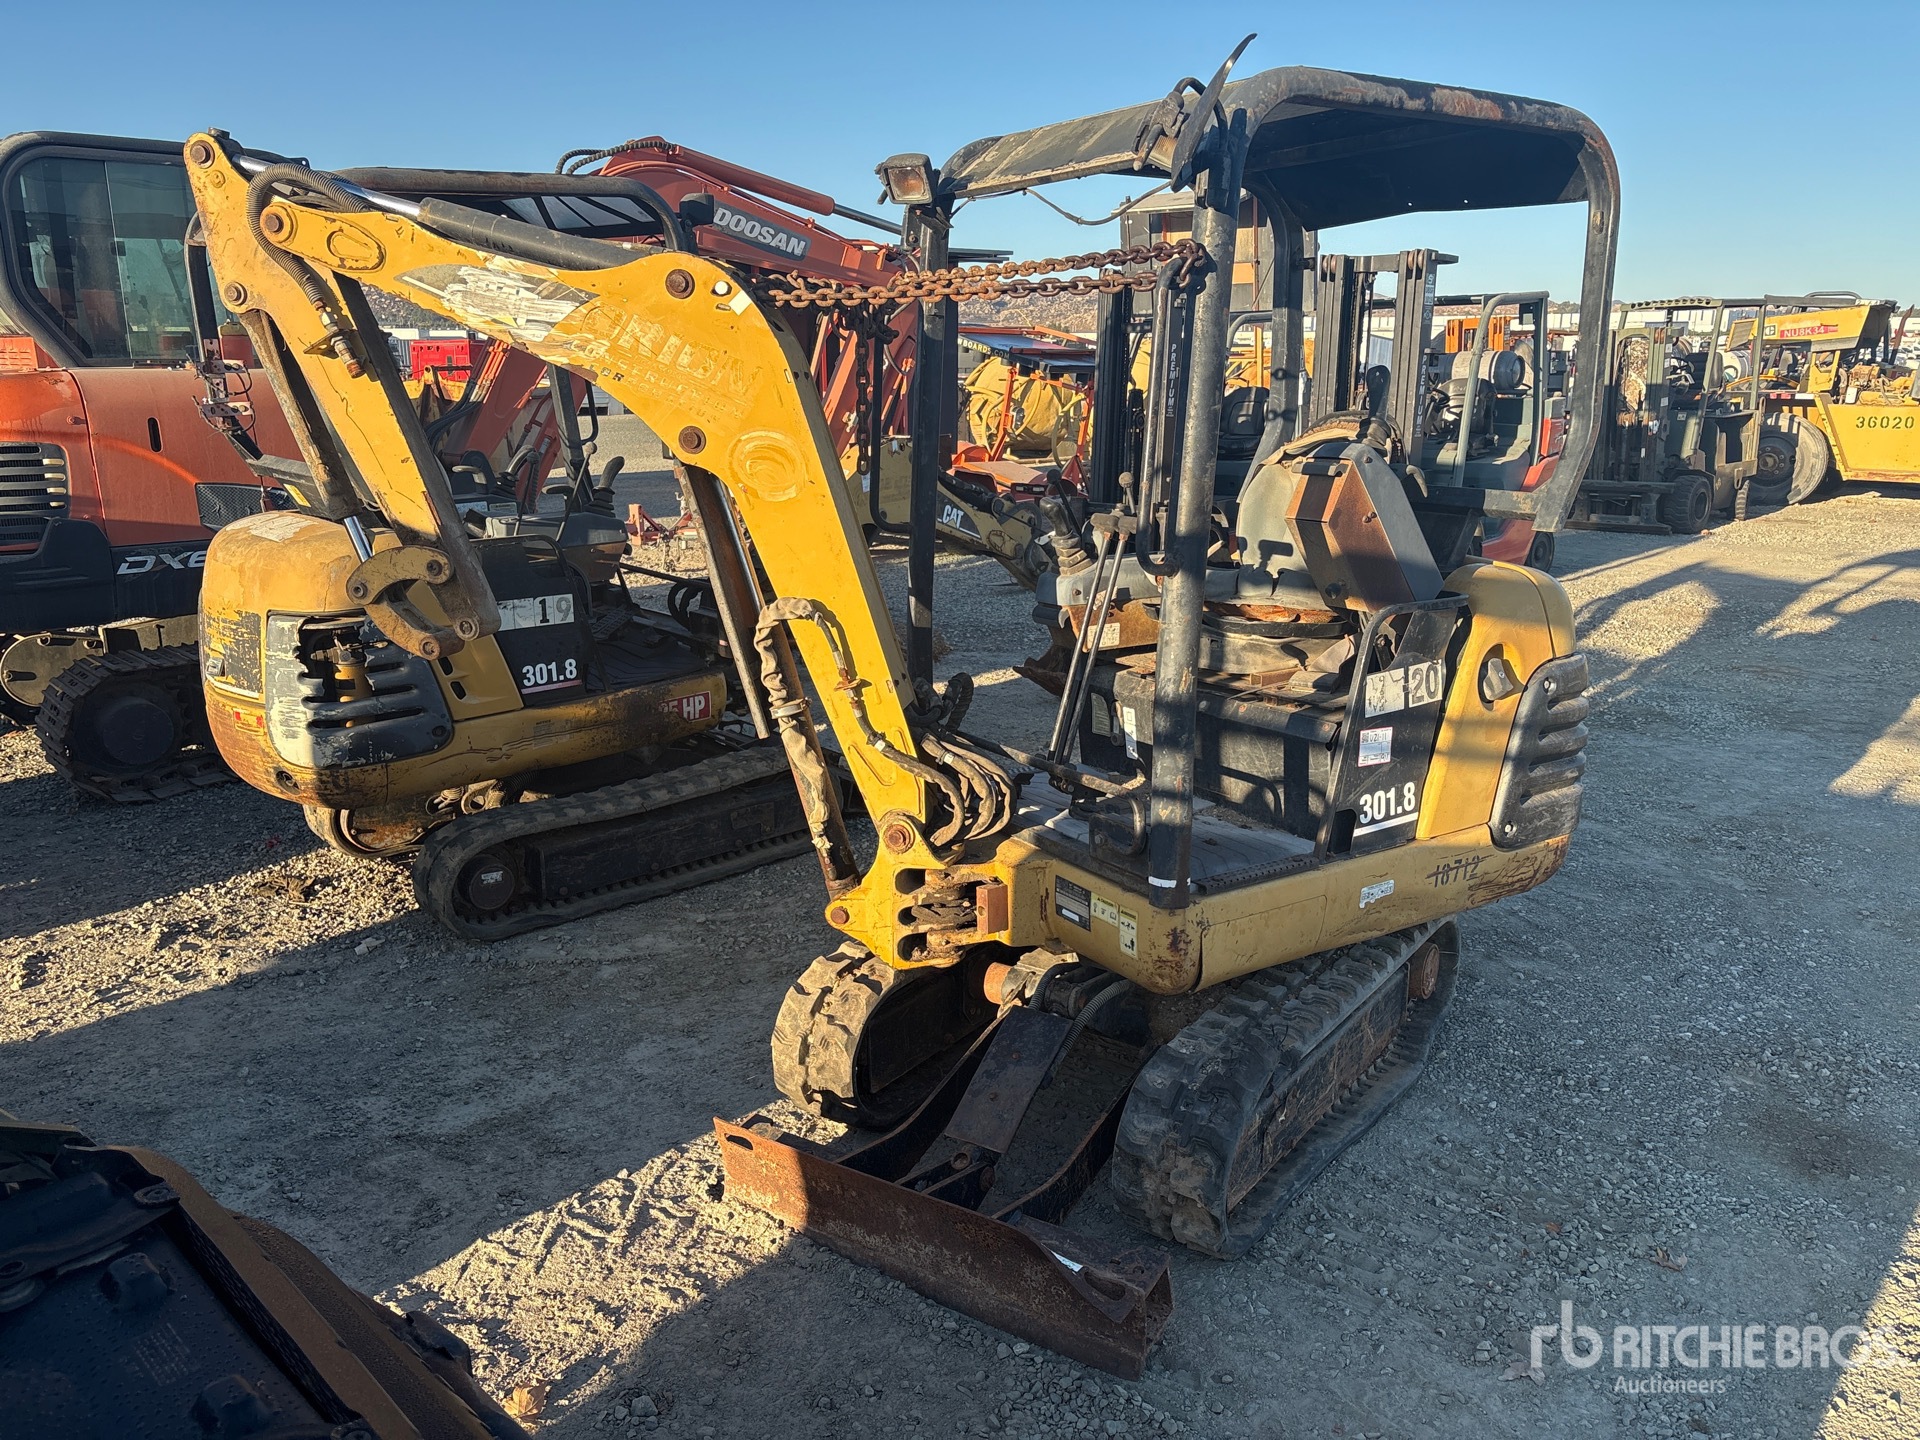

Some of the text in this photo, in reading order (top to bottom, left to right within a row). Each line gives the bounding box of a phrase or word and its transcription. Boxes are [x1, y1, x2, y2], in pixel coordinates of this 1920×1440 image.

[713, 207, 806, 256] DOOSAN
[1783, 325, 1825, 338] NU8K34
[1167, 343, 1178, 406] PREMIUM
[1416, 354, 1428, 425] PREMIUM
[1856, 415, 1915, 429] 36020
[942, 504, 965, 529] CAT
[521, 658, 578, 687] 301.8
[1411, 663, 1440, 704] 20
[682, 695, 705, 720] HP
[1359, 781, 1416, 824] 301.8
